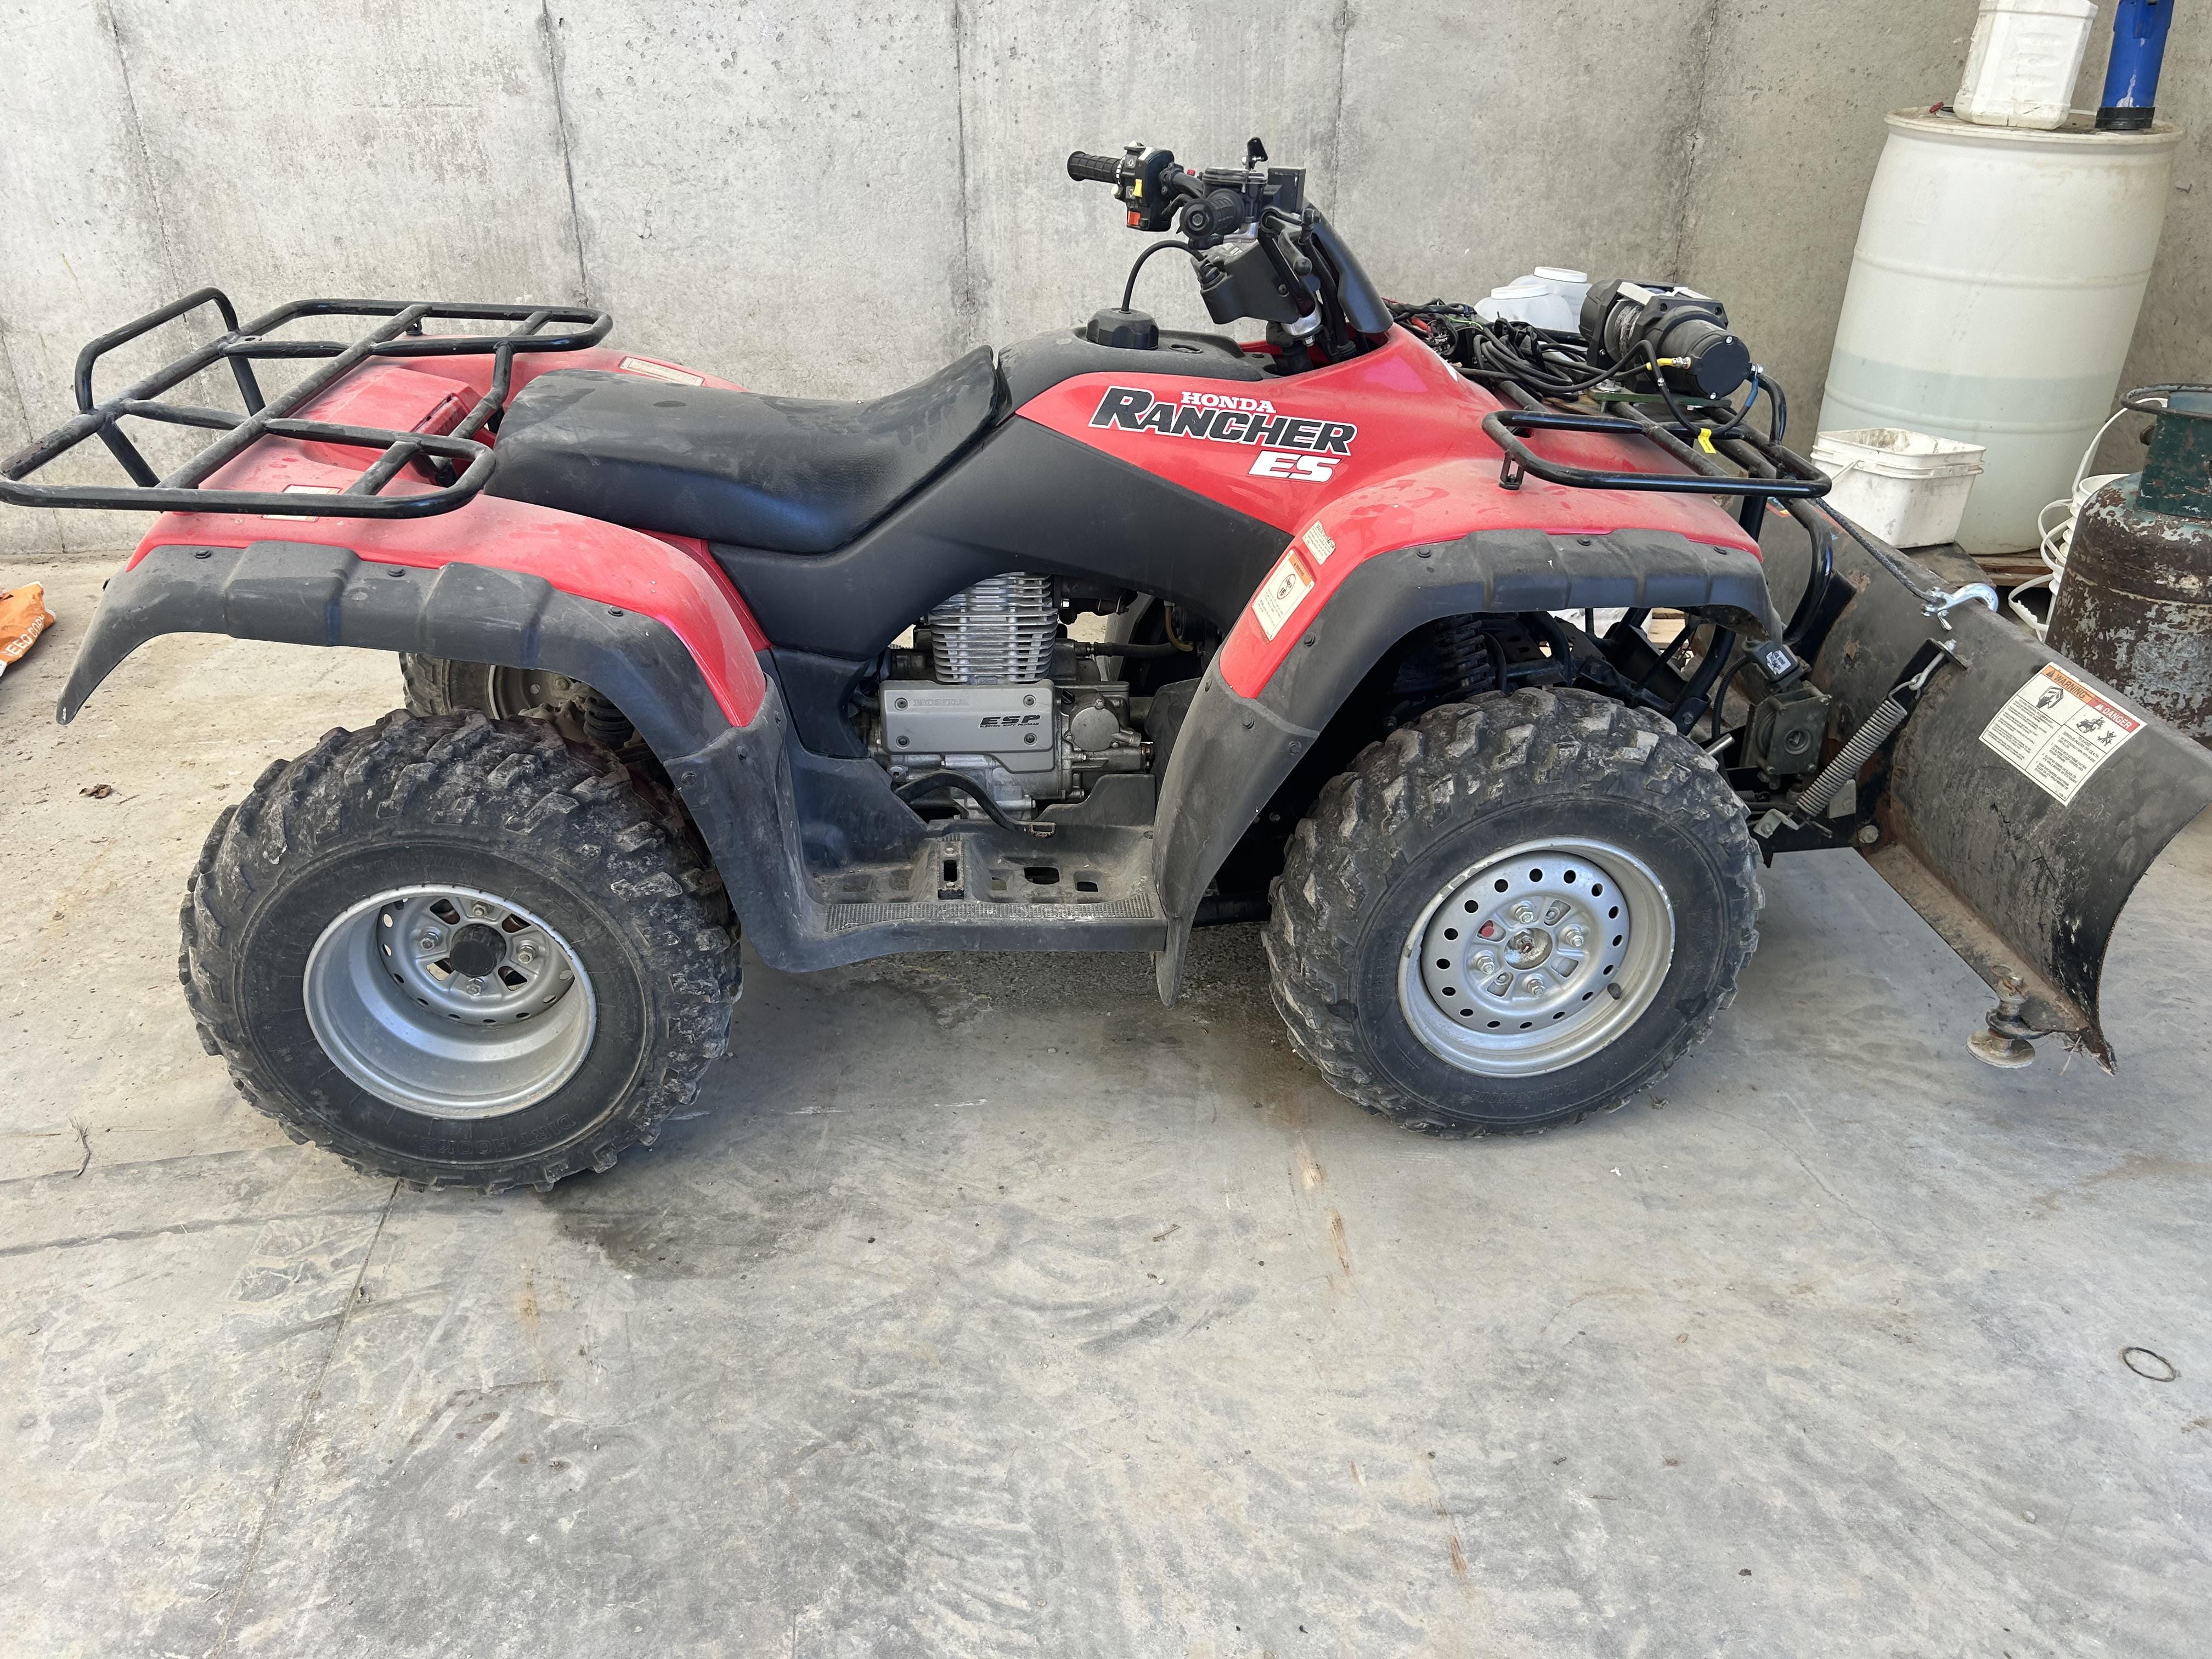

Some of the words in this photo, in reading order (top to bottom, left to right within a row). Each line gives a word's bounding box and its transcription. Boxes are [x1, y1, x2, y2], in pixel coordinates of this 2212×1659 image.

[1181, 391, 1276, 414] HONDA
[1088, 385, 1358, 456] RANCHER
[1249, 451, 1341, 483] ES
[2053, 674, 2086, 699] WARNING
[913, 698, 970, 707] HONDA
[980, 714, 1041, 725] ESP
[2102, 706, 2132, 729] DANGER
[521, 1114, 576, 1147] DIRT
[420, 1137, 511, 1154] HOOKS
